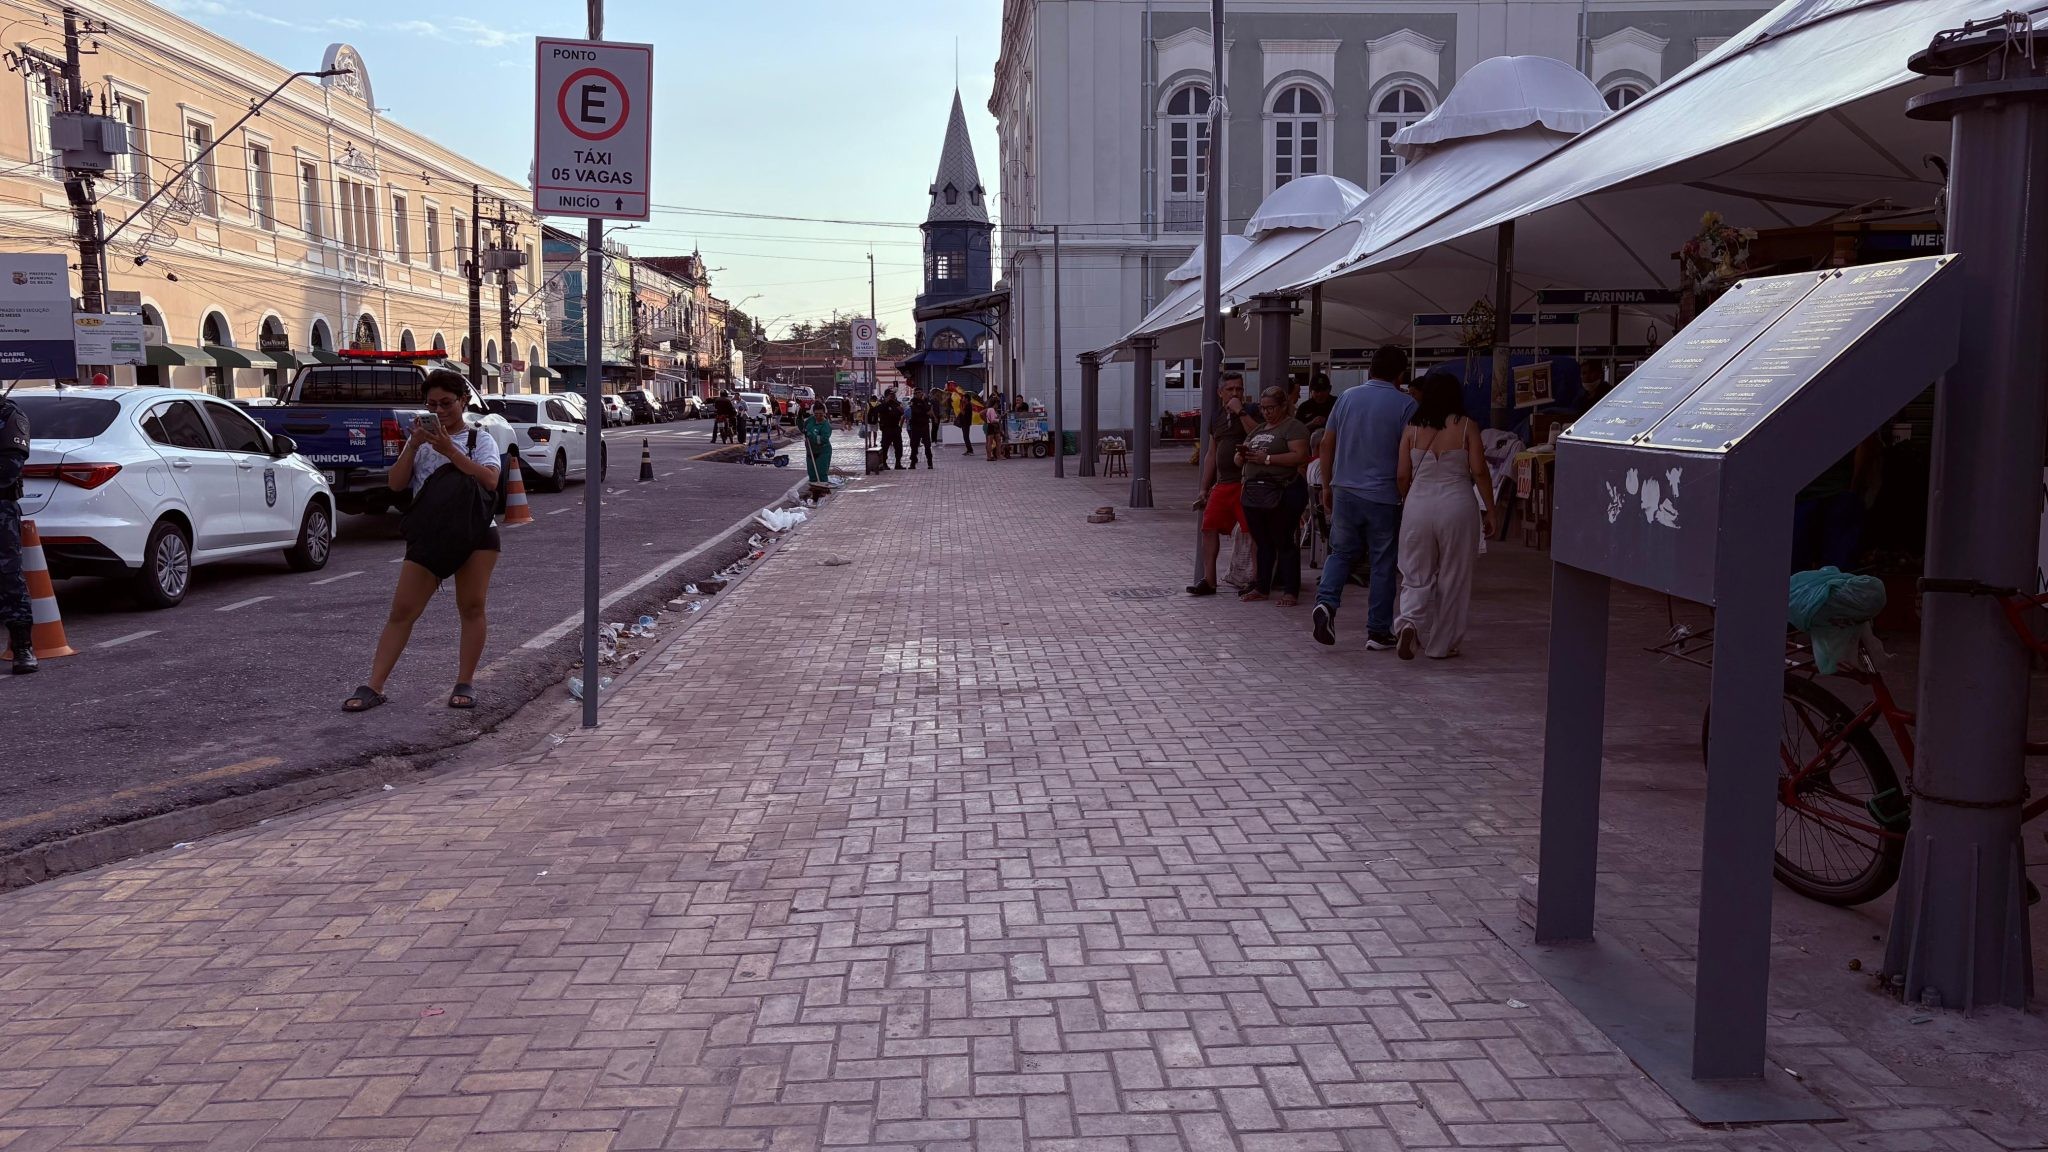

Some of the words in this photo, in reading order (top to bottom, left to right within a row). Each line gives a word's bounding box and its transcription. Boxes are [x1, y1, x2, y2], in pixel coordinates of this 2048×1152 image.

[554, 49, 596, 61] PONTO
[581, 84, 607, 124] E
[574, 149, 612, 165] TÁXI
[552, 168, 570, 181] 05
[575, 170, 633, 185] VAGAS
[1583, 291, 1646, 303] FARINHA
[862, 329, 868, 337] E
